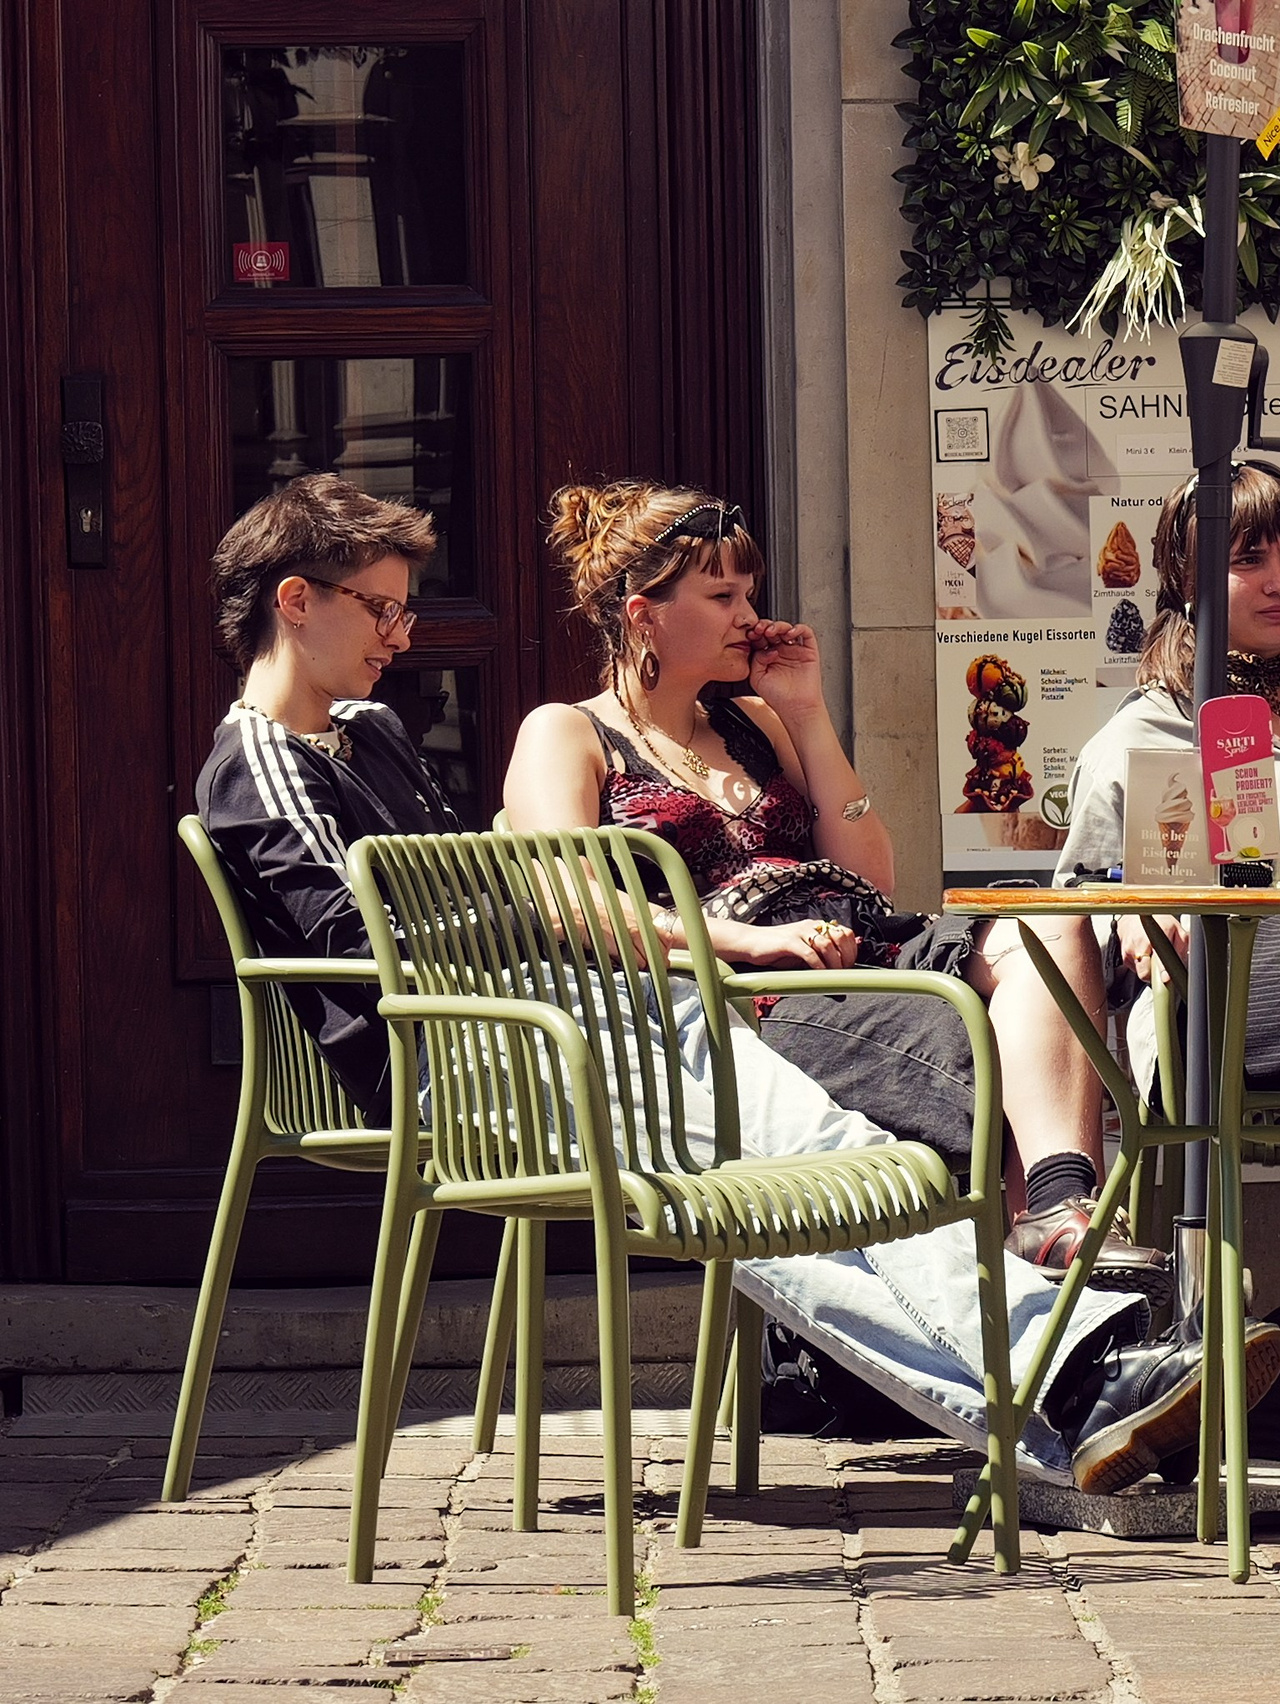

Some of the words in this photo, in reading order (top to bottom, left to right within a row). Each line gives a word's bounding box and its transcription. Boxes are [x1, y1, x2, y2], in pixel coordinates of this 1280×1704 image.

[1193, 23, 1275, 52] Drachenfrucht
[1209, 58, 1257, 82] Coconut
[1205, 91, 1260, 115] Refresher
[1263, 125, 1280, 147] Nice
[935, 339, 1157, 391] Eisdealer
[1100, 394, 1190, 419] SAHN
[1126, 447, 1143, 455] Mini
[1168, 447, 1188, 455] Klein
[1111, 496, 1145, 507] Natur
[1147, 496, 1164, 507] od
[1093, 590, 1136, 598] Zimthaube
[937, 630, 1009, 643] Verschiedene
[1012, 629, 1043, 644] Kugel
[1046, 629, 1097, 642] Eissorten
[1104, 656, 1142, 665] Lakritzflak
[1217, 736, 1255, 749] SARTI
[1234, 767, 1259, 779] SCHON
[1236, 778, 1273, 791] PROBIERT?
[1049, 791, 1069, 799] VEGA
[1141, 829, 1169, 841] Bitte
[1170, 829, 1199, 842] beim
[1142, 846, 1197, 860] Eisdealer
[1140, 863, 1197, 877] bestellen.
